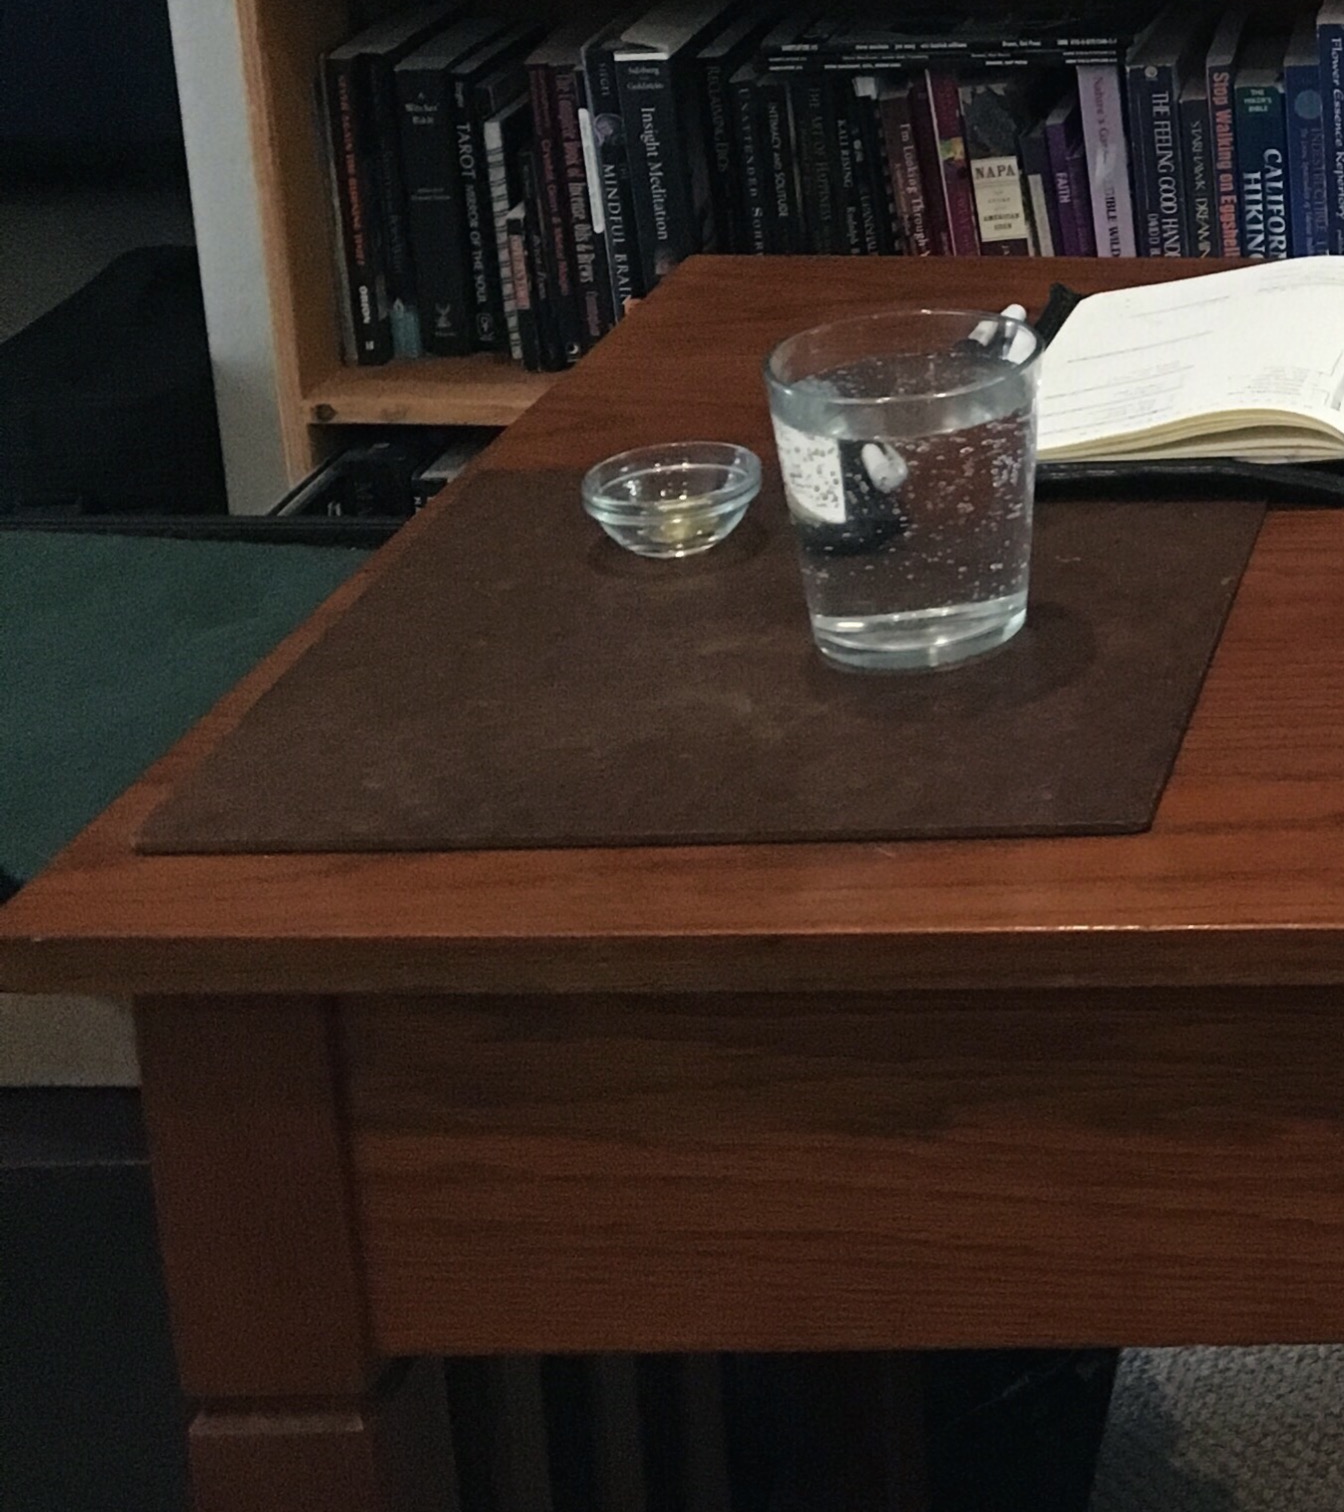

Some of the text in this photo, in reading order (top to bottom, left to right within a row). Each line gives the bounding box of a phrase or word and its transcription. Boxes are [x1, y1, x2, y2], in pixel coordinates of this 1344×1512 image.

[1331, 37, 1342, 86] Flower
[1334, 89, 1344, 146] Essence
[455, 122, 476, 179] TAROT
[640, 107, 668, 240] Insight Meditation
[974, 167, 1017, 179] NAPA
